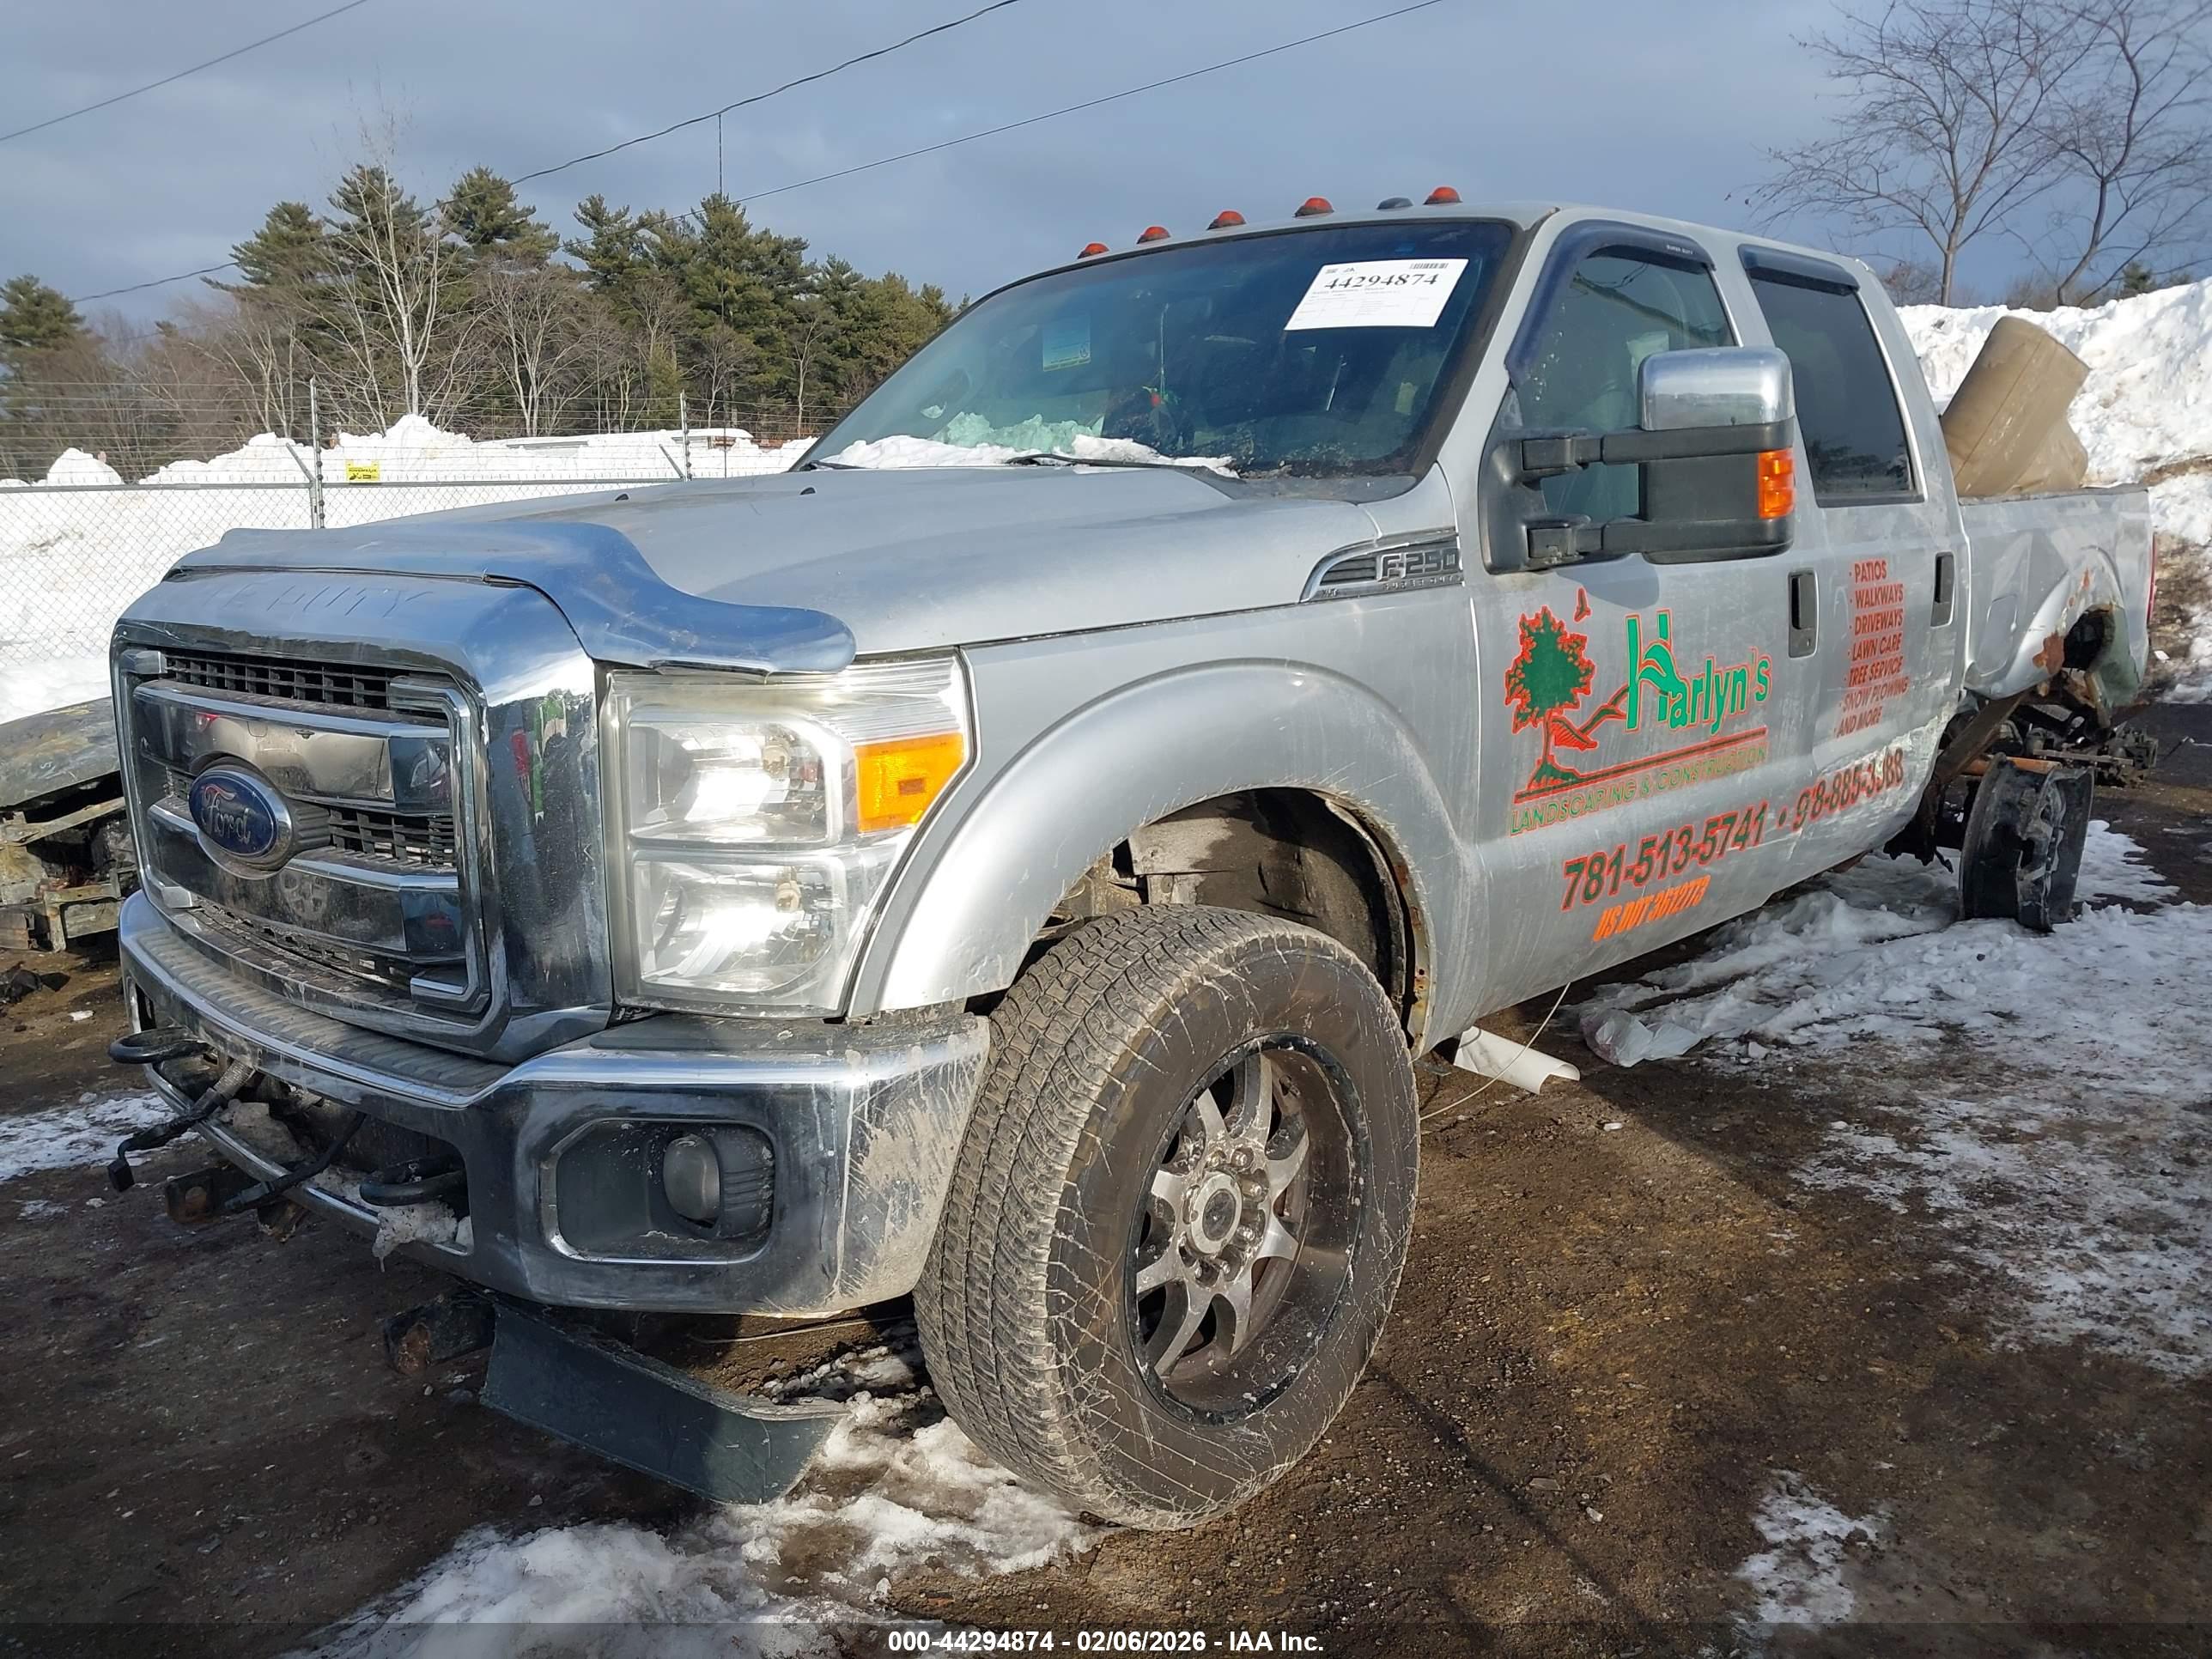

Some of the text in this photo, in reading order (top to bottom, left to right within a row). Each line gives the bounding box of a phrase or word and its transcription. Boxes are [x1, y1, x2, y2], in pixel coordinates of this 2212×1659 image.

[1324, 272, 1440, 289] 44294874
[1854, 559, 1887, 583] PATIOS
[1855, 583, 1904, 610] WALKWAYS
[1854, 608, 1904, 636] DRIVEWAYS
[1851, 632, 1902, 662] LAWN CARE
[1622, 610, 1771, 736] Harlyn's
[1848, 655, 1904, 688] TREE SERVICE
[1843, 687, 1872, 712] SNOW
[1837, 706, 1883, 738] AND MORE
[1510, 742, 1769, 836] LANDSCAPING & CONSTRUCTION
[201, 782, 253, 846] Ford
[1561, 800, 1769, 913] 781-513-5741
[1593, 904, 1623, 942] US
[1614, 895, 1656, 934] DOT
